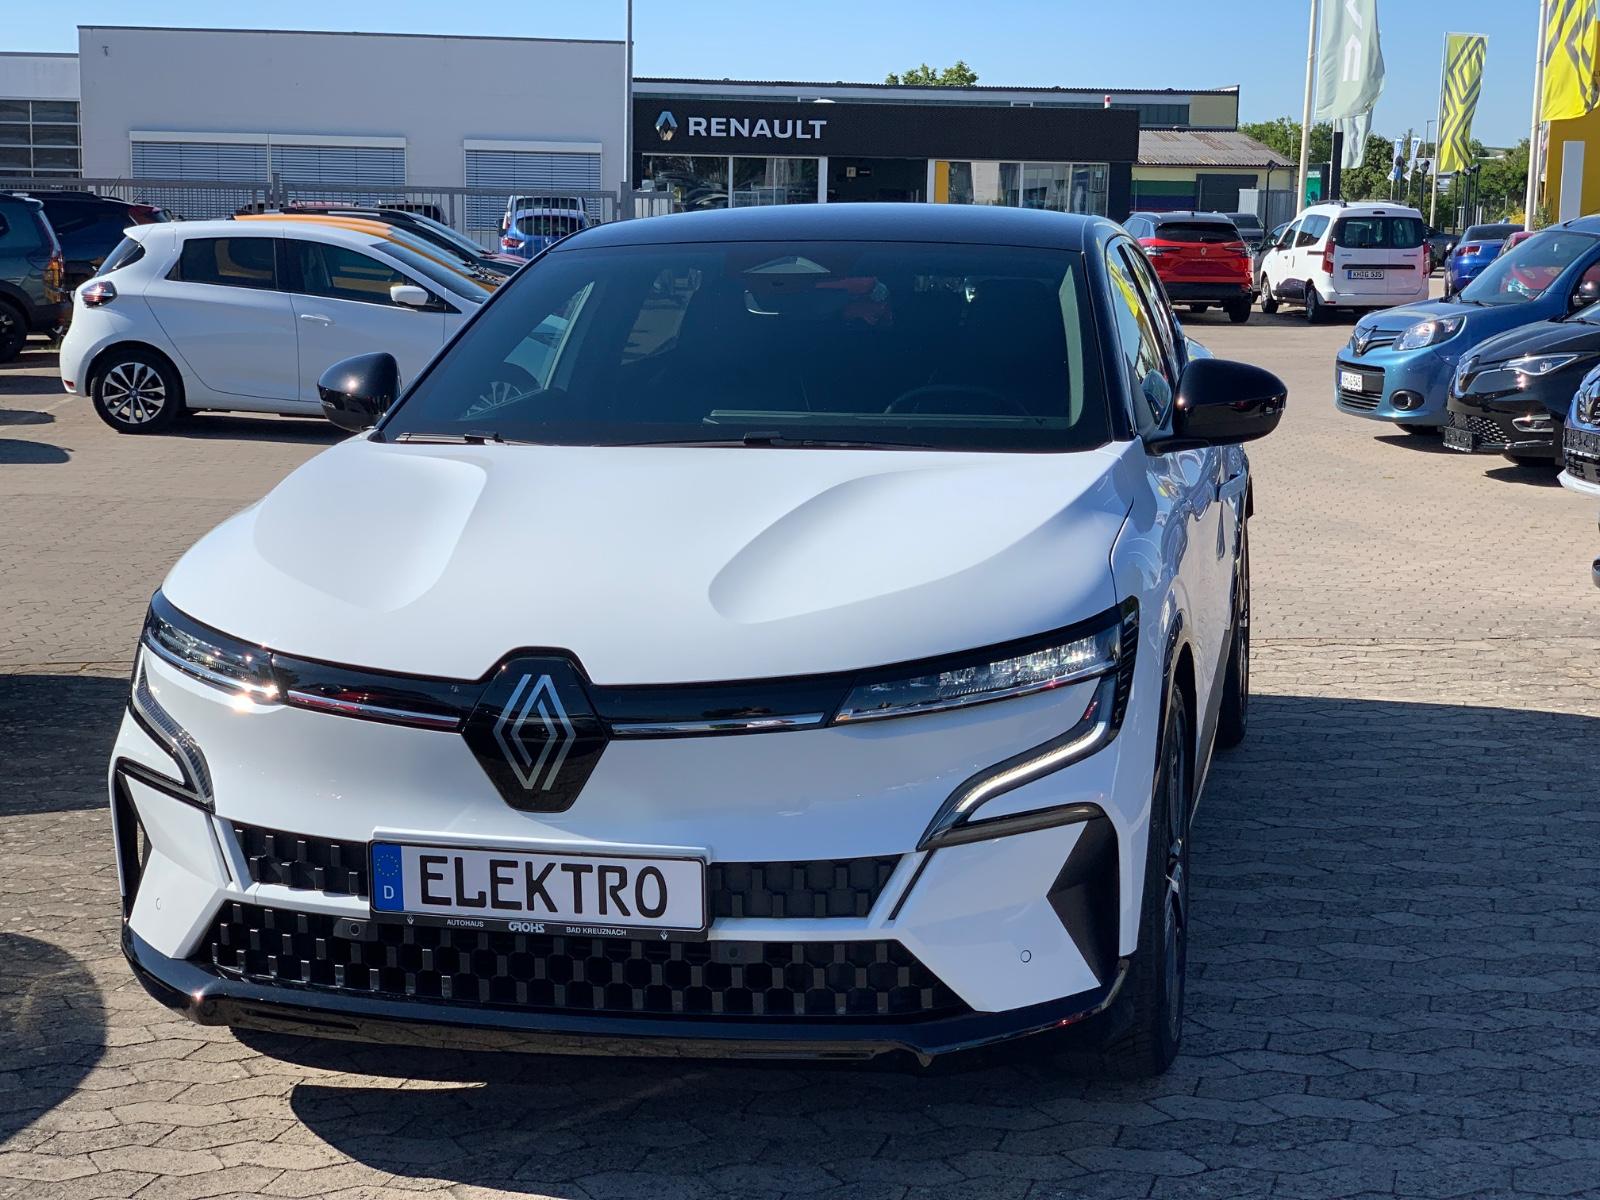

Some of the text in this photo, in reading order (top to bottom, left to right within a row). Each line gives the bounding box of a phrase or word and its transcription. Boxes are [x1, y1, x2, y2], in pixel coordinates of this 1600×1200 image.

[688, 117, 827, 139] RENAULT
[383, 885, 395, 900] D
[419, 855, 668, 918] ELEKTRO
[446, 919, 484, 928] AUTOHAUS
[566, 926, 581, 935] BAD
[582, 927, 627, 937] KREUZNACH
